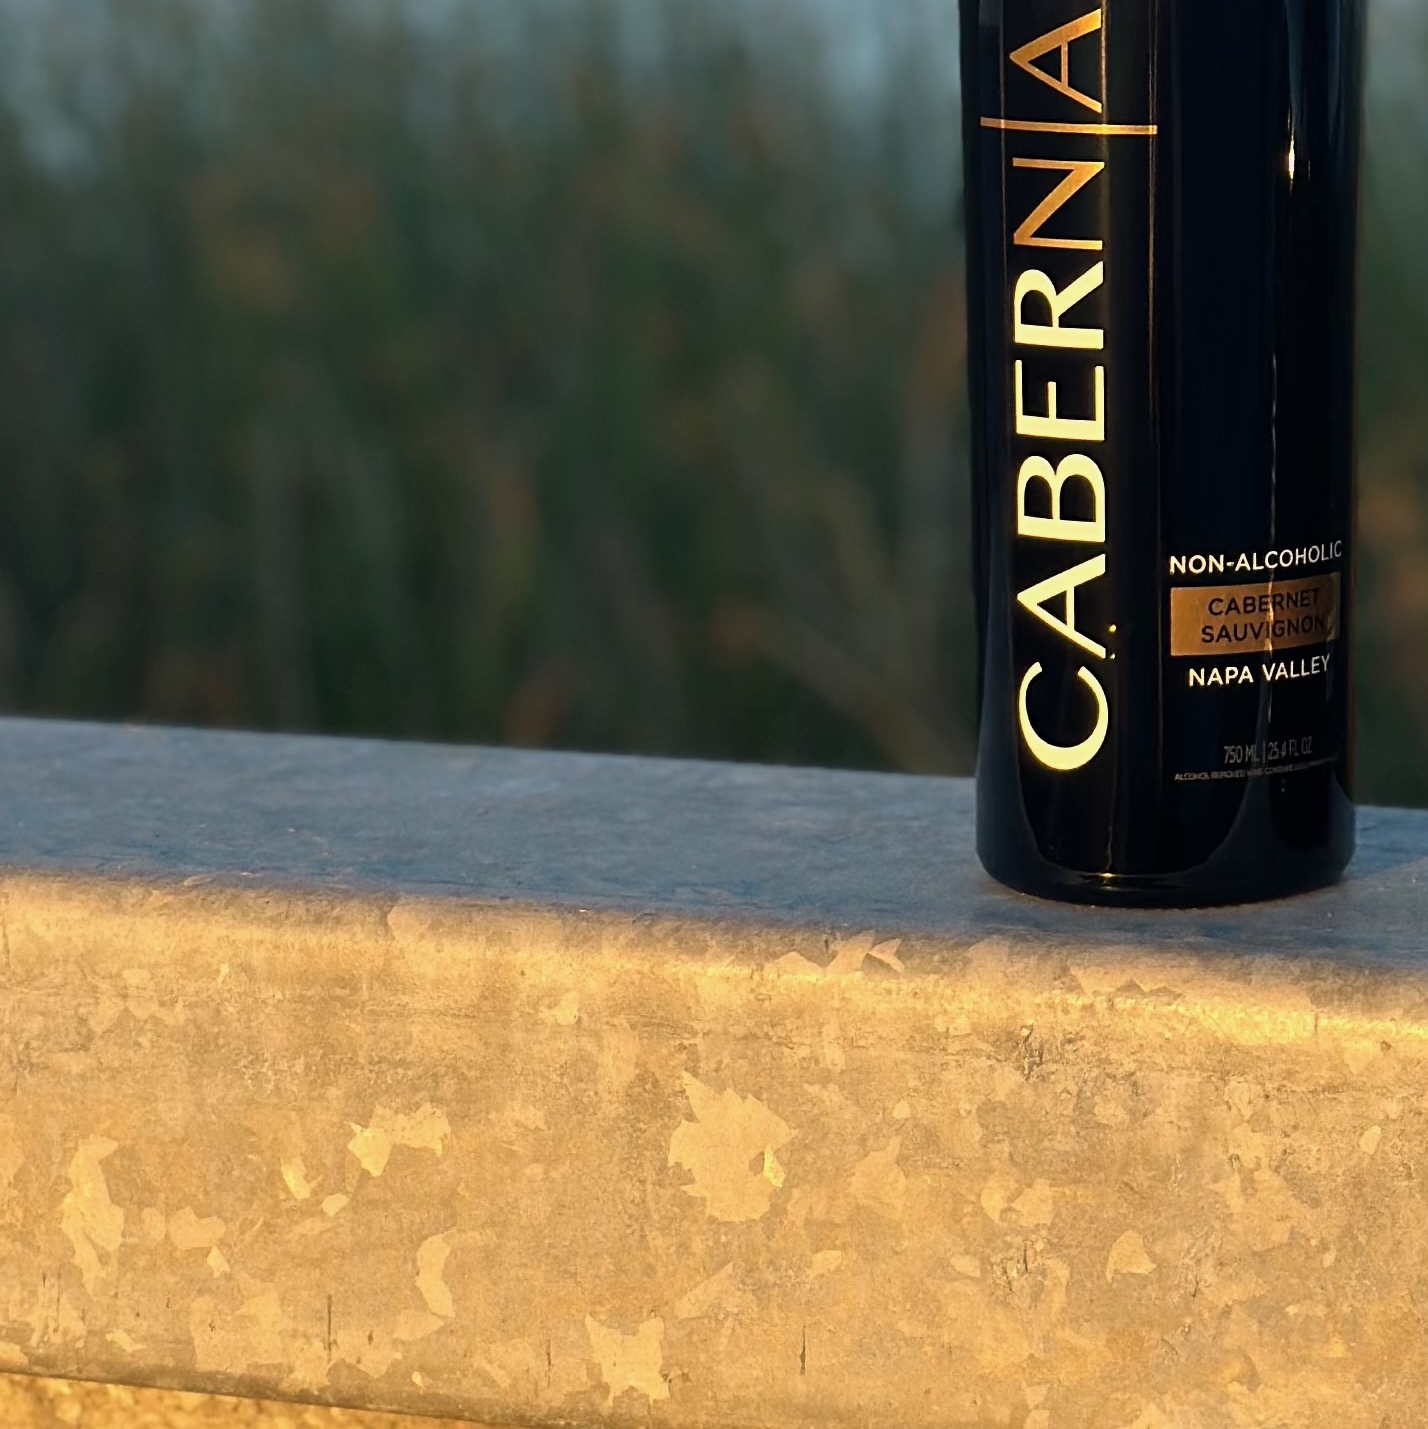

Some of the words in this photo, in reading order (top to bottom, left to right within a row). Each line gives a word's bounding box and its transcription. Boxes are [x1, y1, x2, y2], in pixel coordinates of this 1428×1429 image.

[1169, 539, 1342, 575] NON-ALCOHOLIC
[1207, 587, 1321, 616] CABERNET
[1201, 615, 1326, 644] SAUVIGNON
[1188, 665, 1254, 687] NAPA
[1262, 653, 1331, 683] VALLEY
[1223, 745, 1243, 764] 750
[1245, 744, 1260, 763] ML
